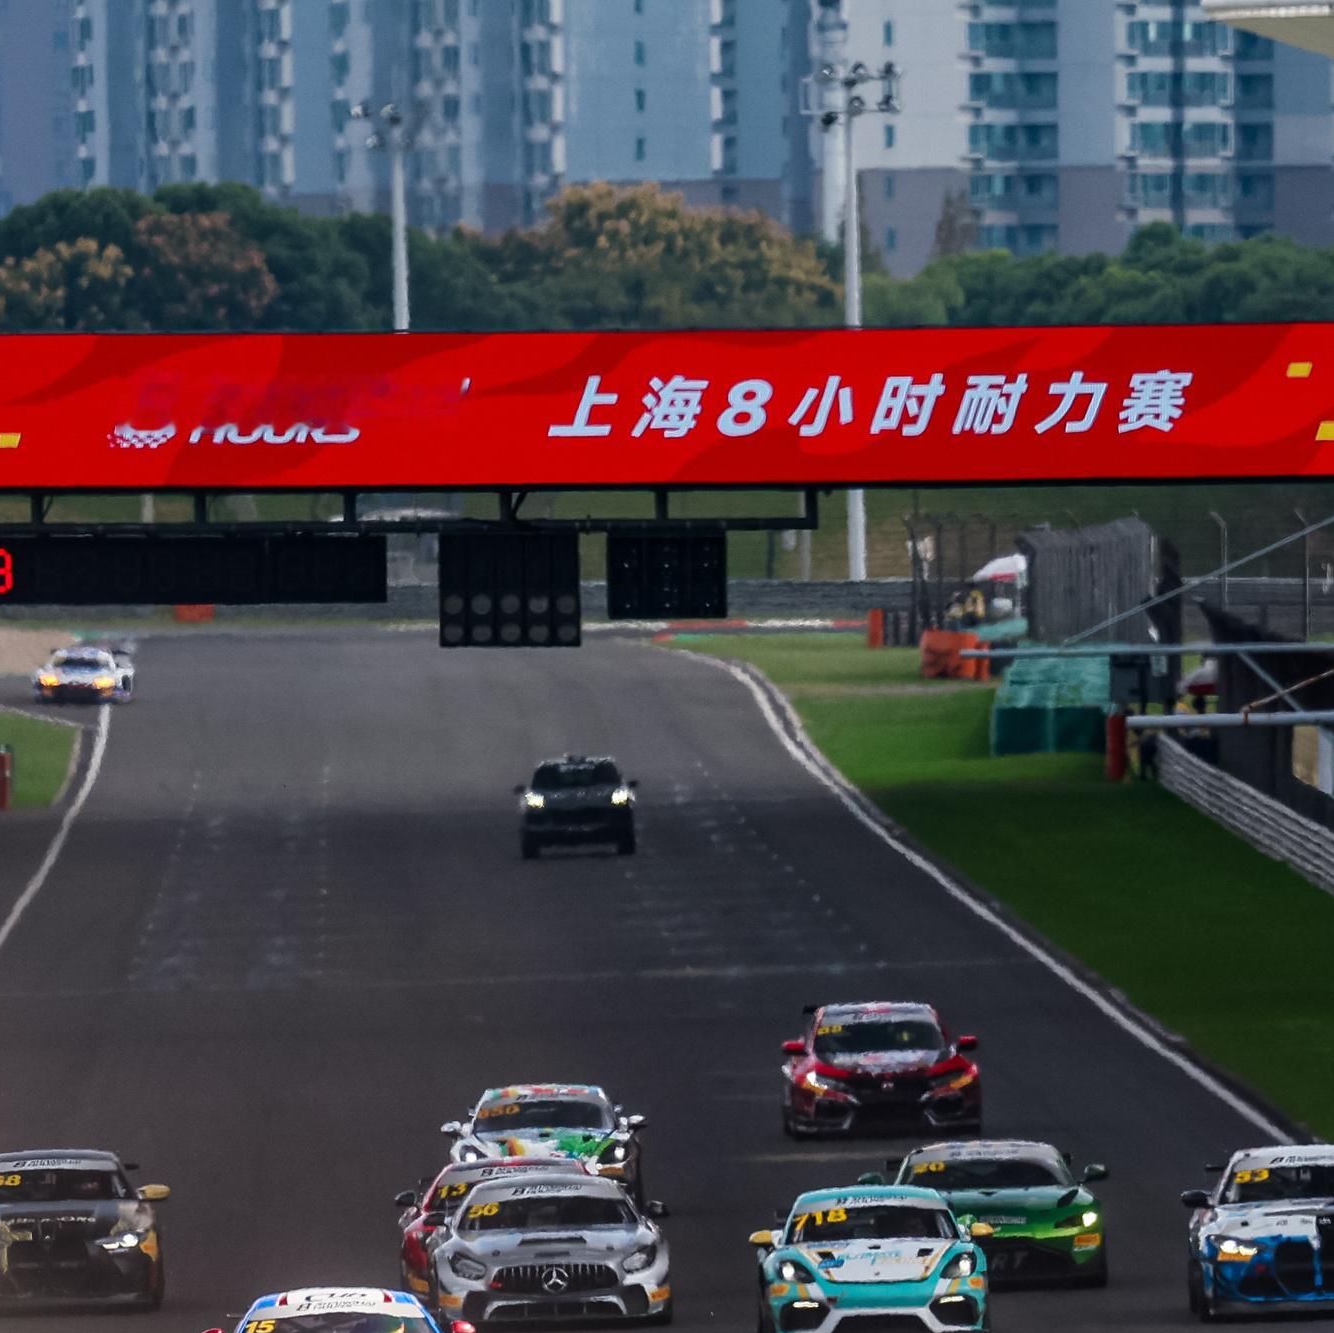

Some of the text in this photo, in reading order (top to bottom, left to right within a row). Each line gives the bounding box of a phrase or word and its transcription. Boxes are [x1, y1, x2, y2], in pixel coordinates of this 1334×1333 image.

[548, 368, 1195, 438] 上海8小时耐力赛
[438, 1184, 468, 1198] 13
[794, 1207, 848, 1231] 718
